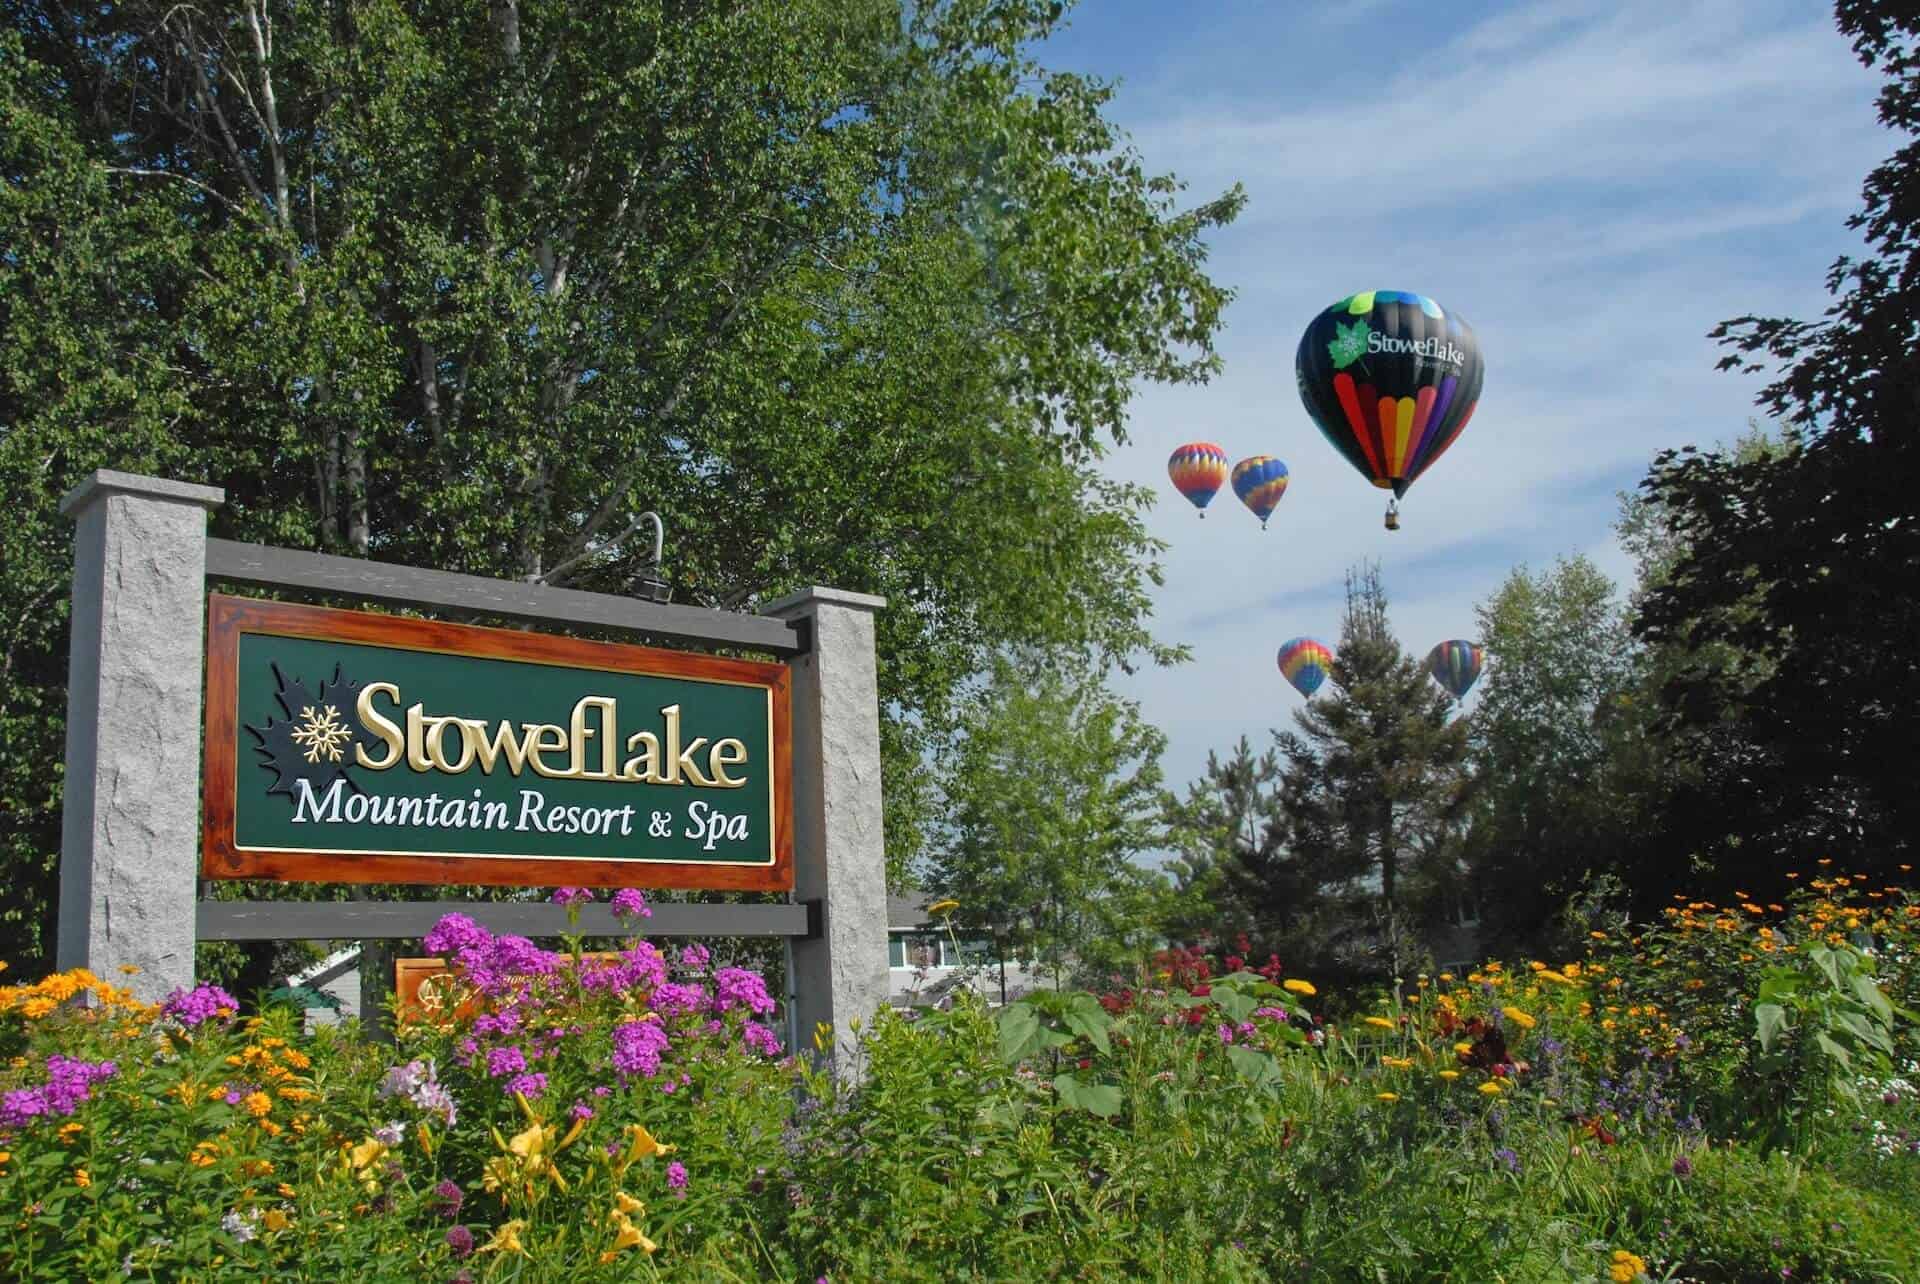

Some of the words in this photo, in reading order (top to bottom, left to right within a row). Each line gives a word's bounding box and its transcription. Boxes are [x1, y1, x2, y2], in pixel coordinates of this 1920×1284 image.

[1367, 331, 1465, 367] Stoweflake
[355, 681, 748, 788] Stoweflake
[291, 778, 510, 830] Mountain
[514, 789, 635, 836] Resort
[648, 810, 672, 837] &
[685, 800, 749, 850] Spa
